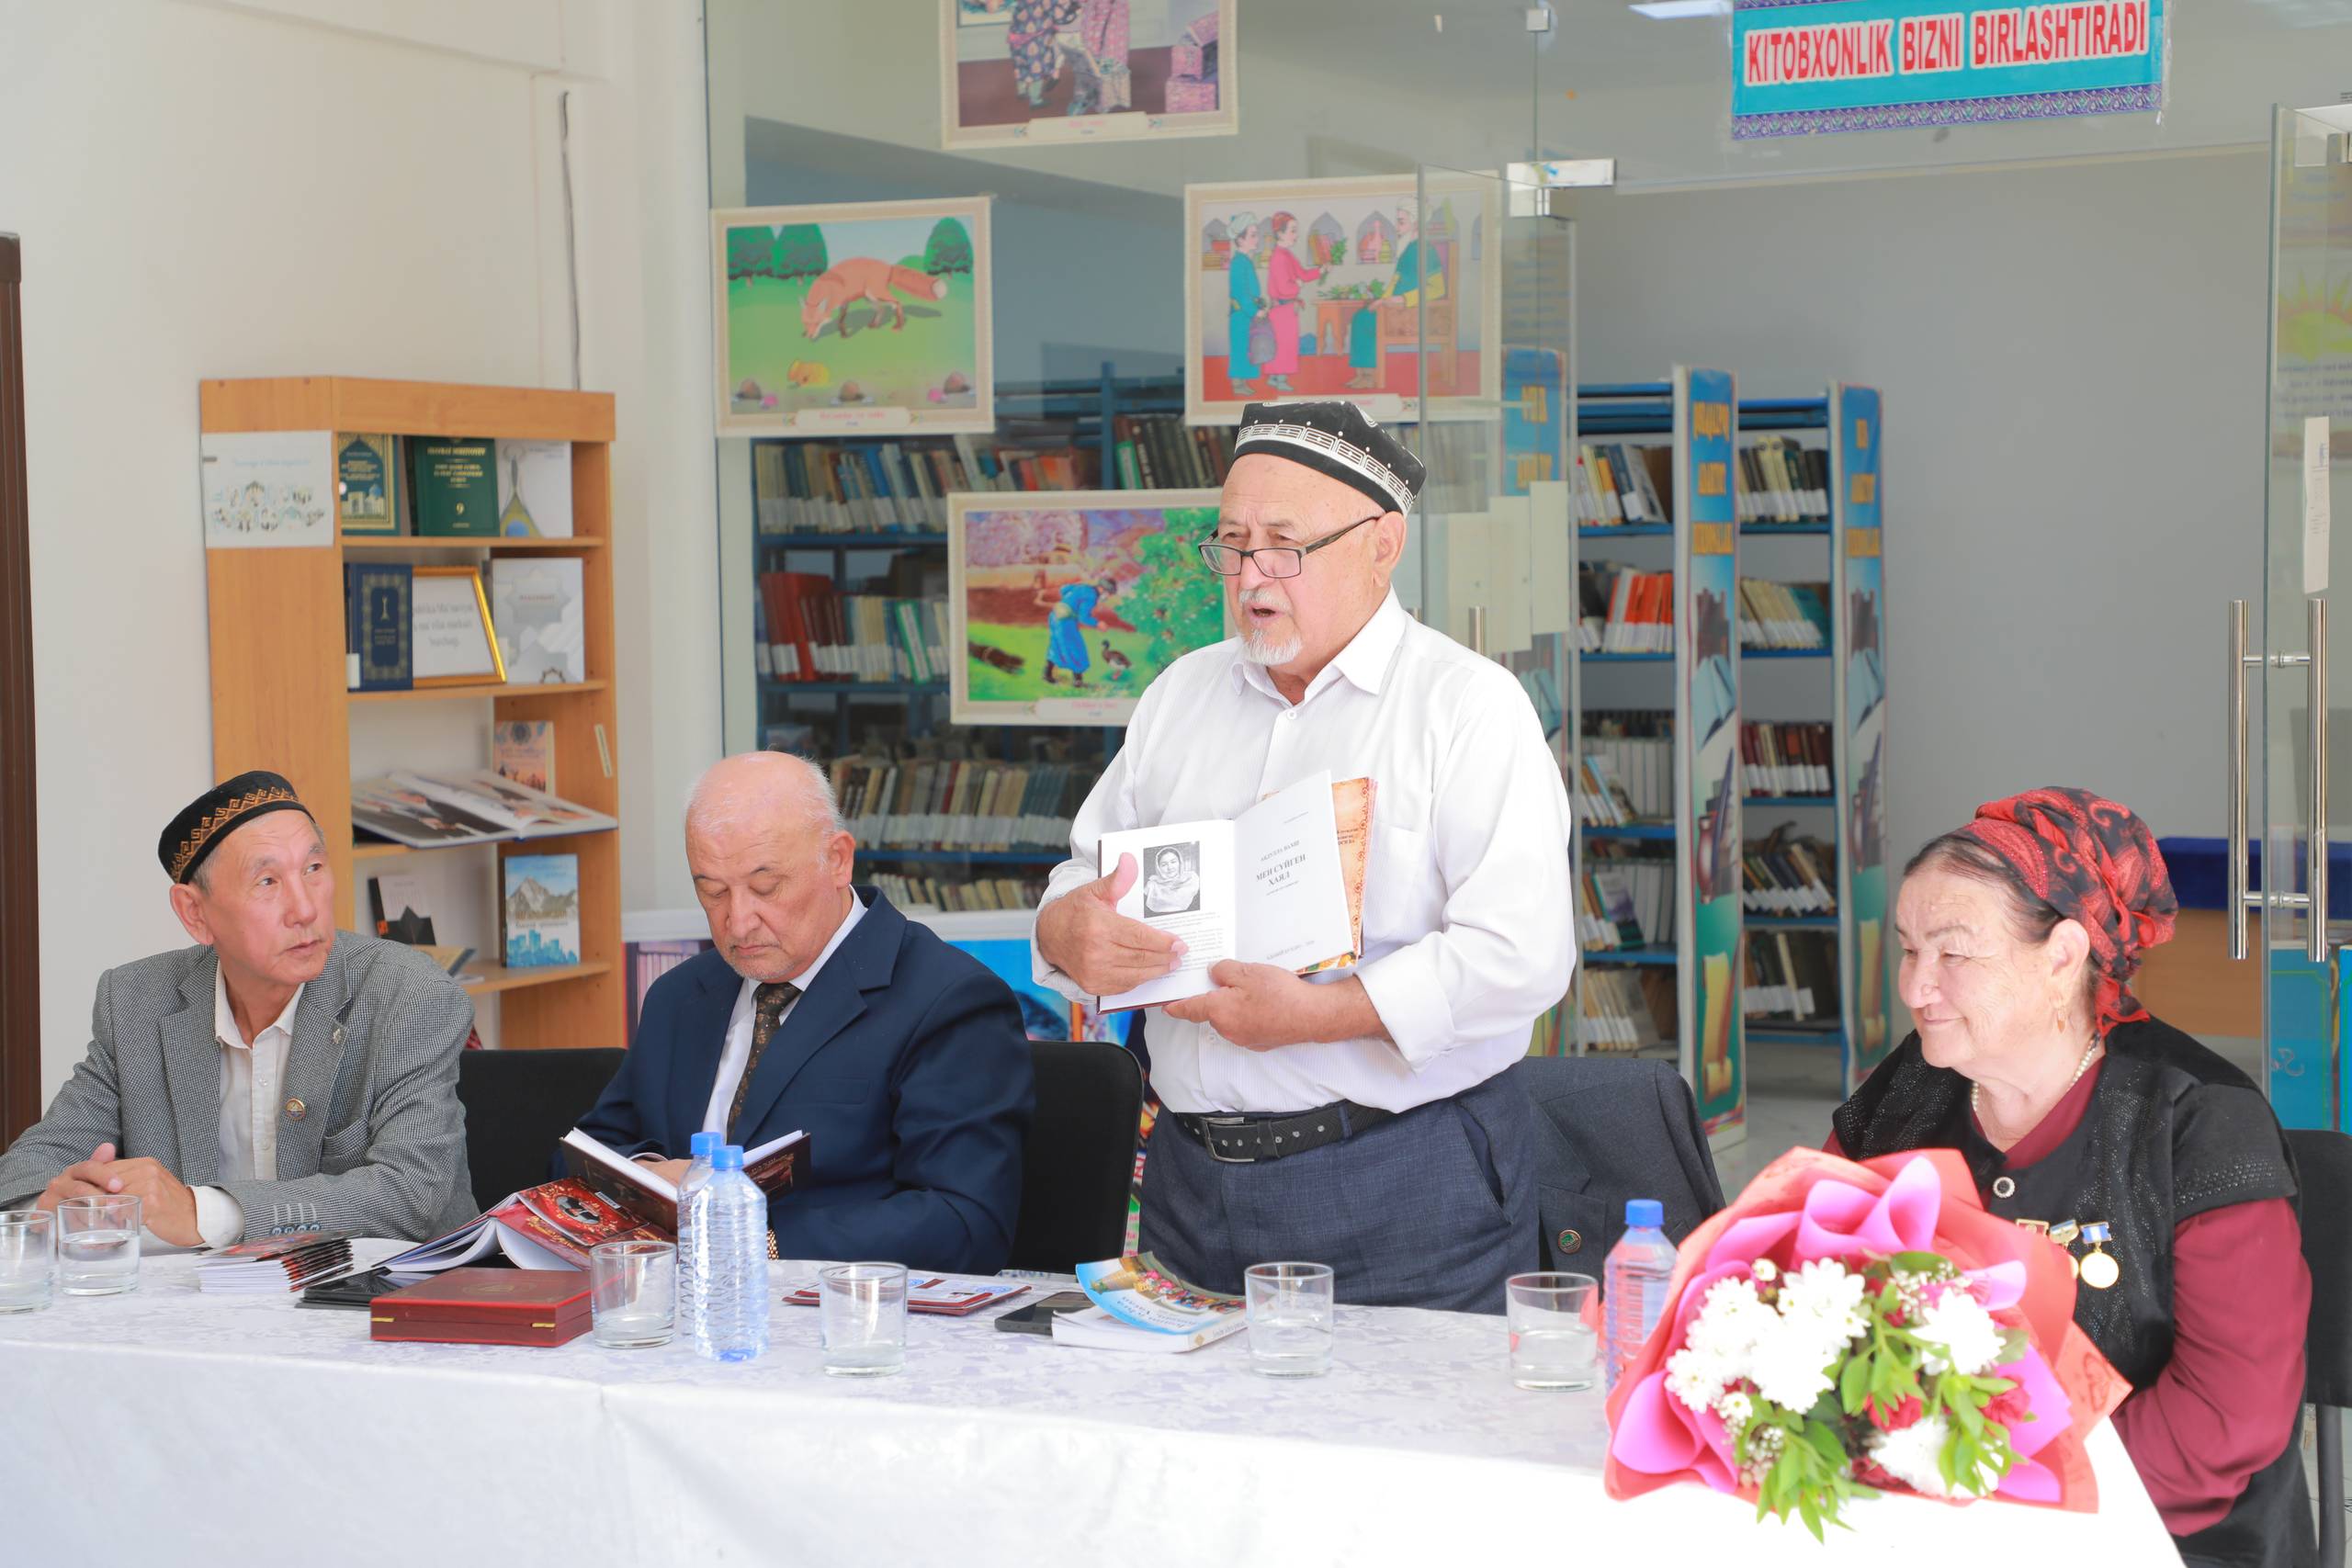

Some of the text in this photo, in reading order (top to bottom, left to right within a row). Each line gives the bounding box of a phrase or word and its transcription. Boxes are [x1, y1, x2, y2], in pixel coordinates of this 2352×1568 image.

[1747, 1, 2146, 83] KITOBXONLIK BIZNI BIRLASHTIRADI
